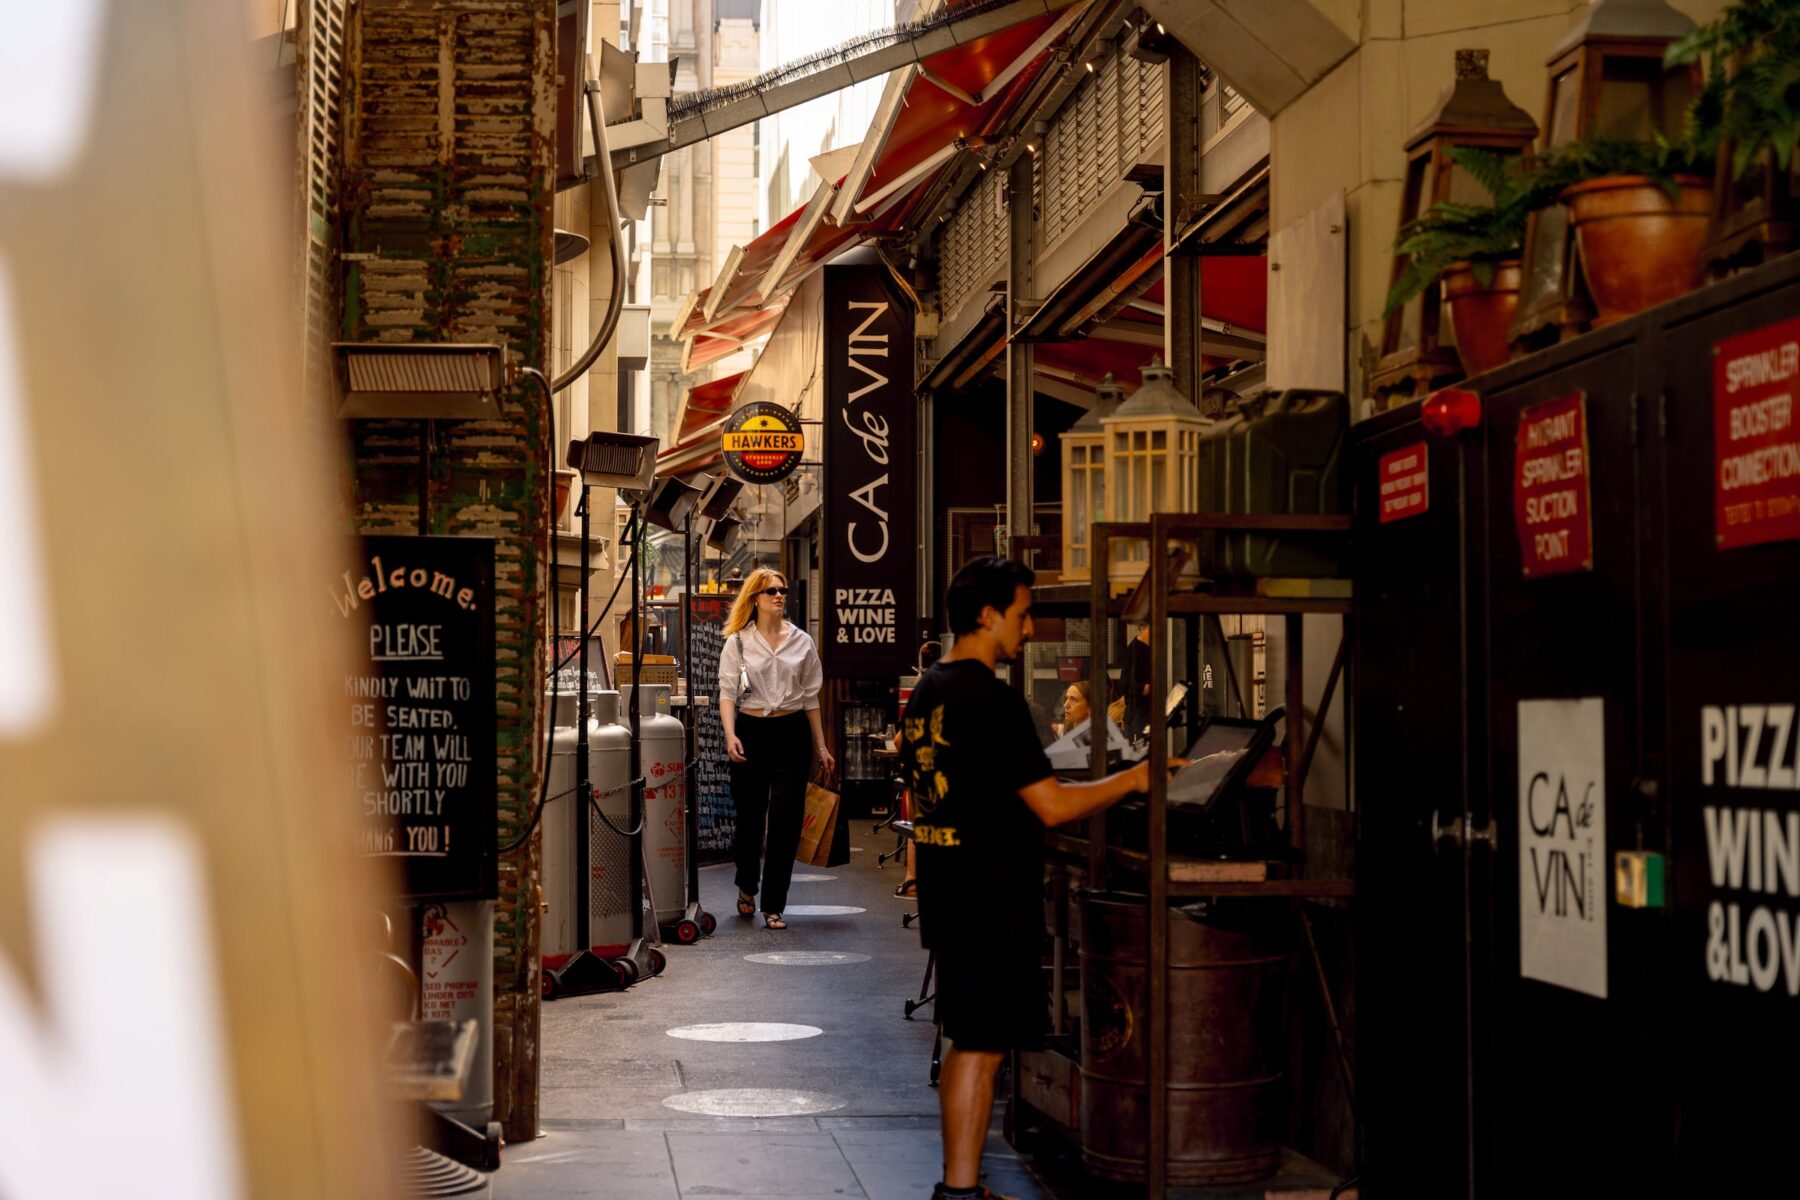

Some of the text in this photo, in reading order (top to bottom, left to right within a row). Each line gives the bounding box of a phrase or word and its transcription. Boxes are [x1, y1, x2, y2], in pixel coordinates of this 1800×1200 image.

[1726, 341, 1799, 393] SPRINKLER
[842, 301, 890, 563] CA de VIN
[1730, 394, 1792, 441] BOOSTER
[731, 435, 796, 449] HAWKERS
[1521, 448, 1583, 489] SPRINKLER
[1525, 490, 1577, 525] SUCTION
[1534, 530, 1570, 561] POINT
[326, 555, 477, 619] Welcome.
[835, 588, 896, 605] PIZZA
[837, 608, 896, 624] WINE
[370, 623, 443, 657] PLEASE
[836, 627, 896, 643] & LOVE
[449, 677, 471, 701] TO
[351, 704, 458, 730] BE SEATED.
[380, 734, 425, 761] TEAM
[1701, 704, 1800, 790] PIZZ
[436, 763, 468, 788] YOU
[364, 788, 446, 815] SHORTLY
[1528, 772, 1575, 840] CA
[406, 826, 438, 851] YOU
[1704, 806, 1800, 897] WIN
[1530, 848, 1586, 919] VIN
